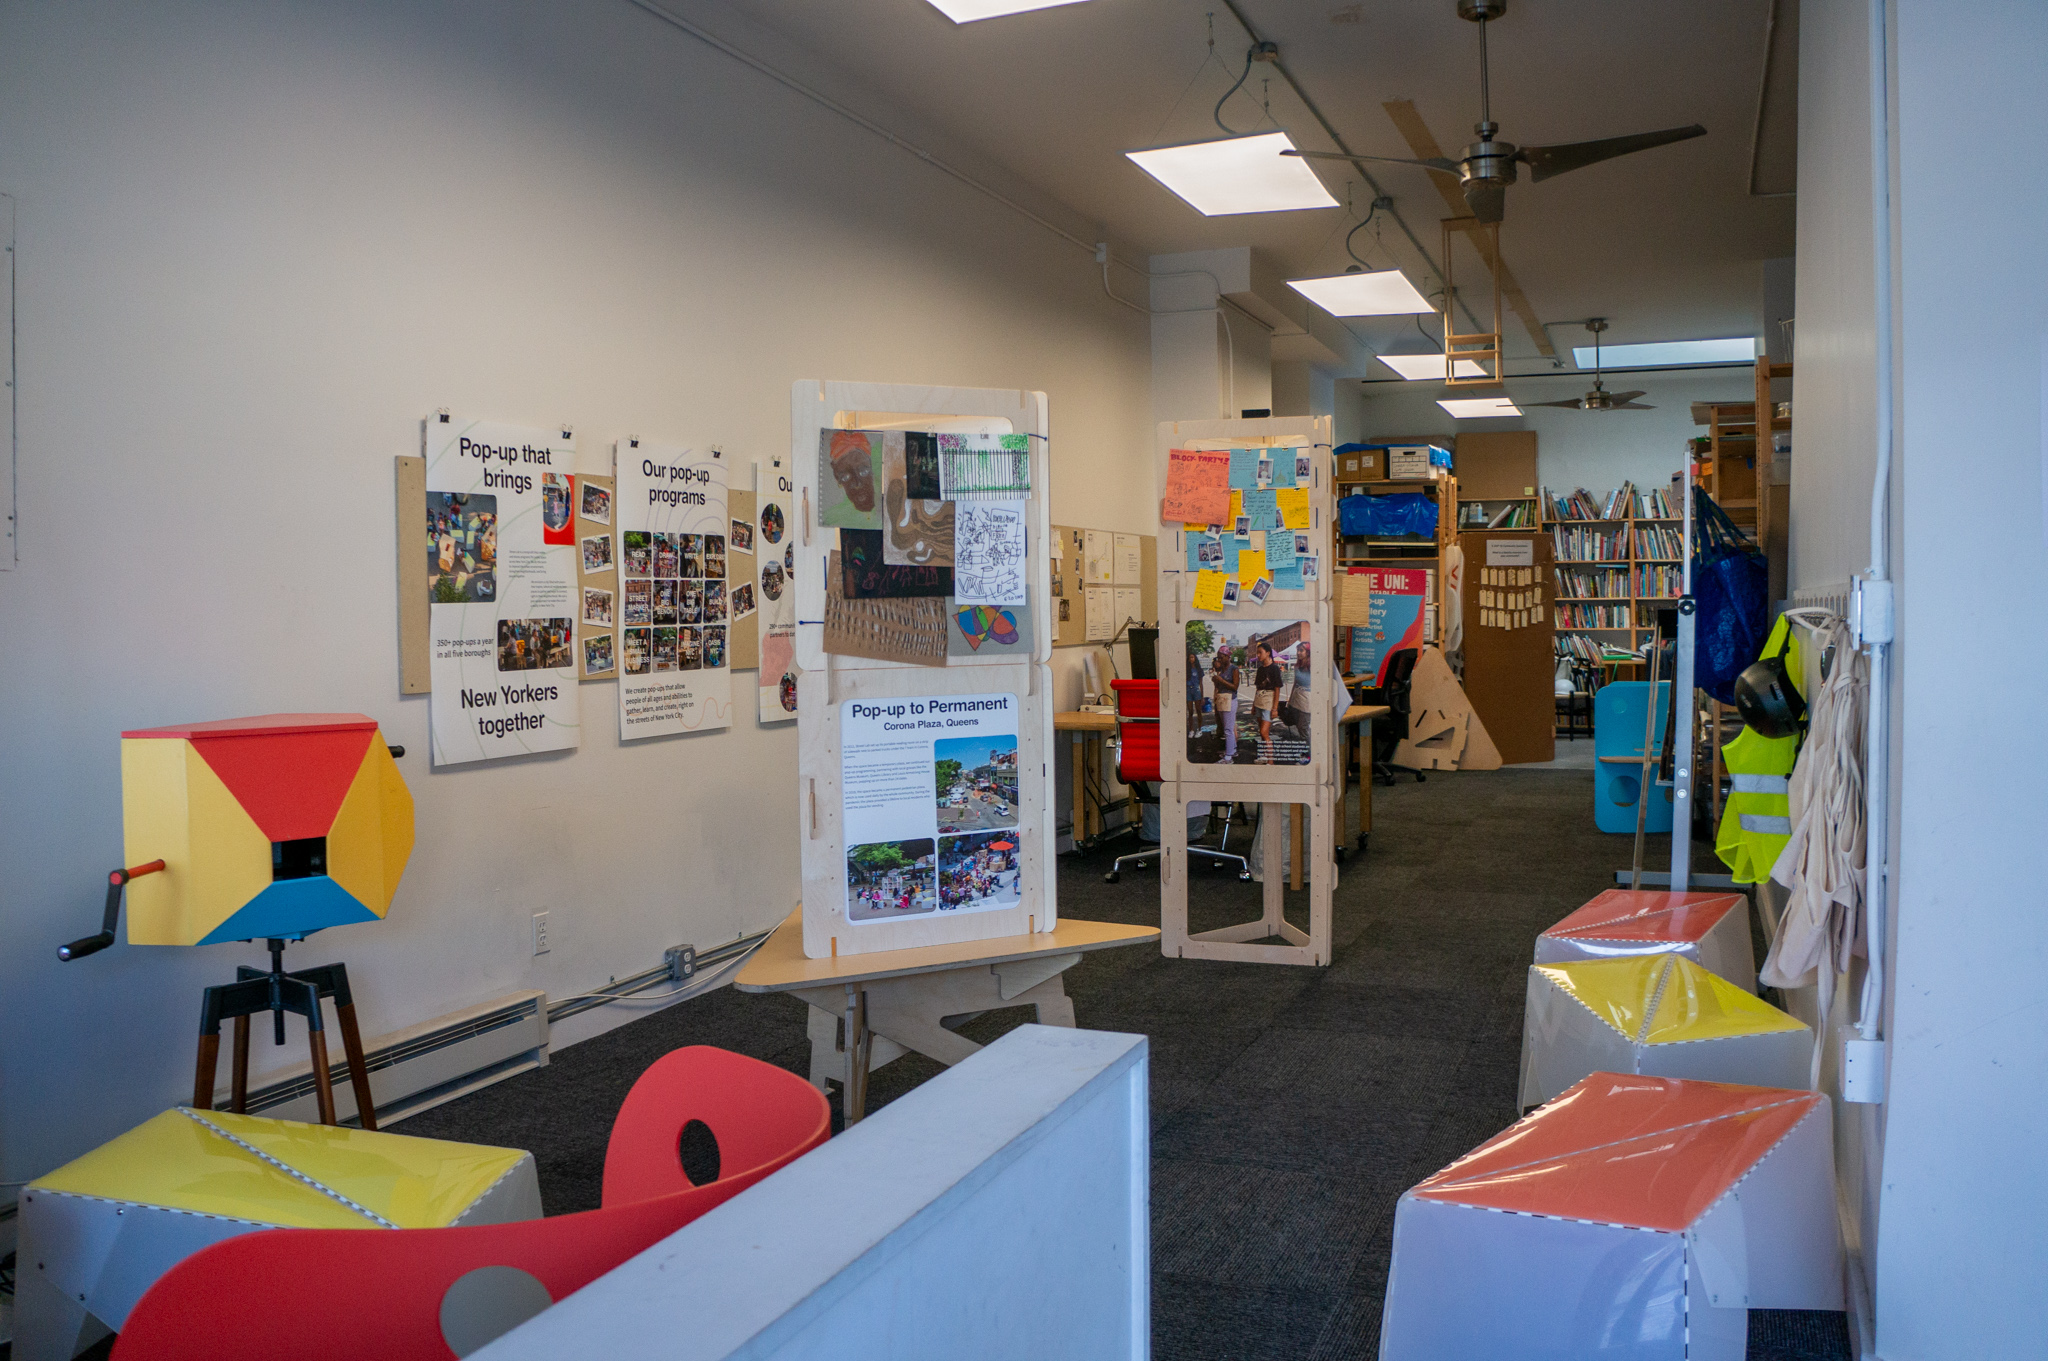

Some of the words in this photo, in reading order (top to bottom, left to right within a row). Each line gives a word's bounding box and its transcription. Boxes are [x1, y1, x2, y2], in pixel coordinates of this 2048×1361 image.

[459, 437, 518, 466] Pop-up
[522, 444, 552, 465] that
[484, 467, 533, 494] brings
[642, 459, 666, 478] Our
[670, 465, 710, 486] pop-up
[778, 476, 793, 493] Ou
[649, 488, 706, 508] programs
[1384, 574, 1409, 590] UNI:
[436, 639, 451, 647] 350+
[452, 639, 477, 648] pop-ups
[481, 637, 495, 646] year
[436, 651, 443, 659] in
[444, 650, 452, 658] all
[452, 649, 464, 658] five
[464, 648, 491, 658] boroughs
[460, 688, 497, 709] New
[500, 683, 559, 705] Yorkers
[647, 685, 665, 694] pop-ups
[626, 697, 641, 705] people
[672, 692, 687, 700] abilities
[678, 702, 688, 710] right
[675, 712, 684, 720] City.
[852, 704, 906, 720] Pop-up
[909, 702, 925, 715] to
[929, 697, 1008, 714] Permanent
[478, 711, 545, 739] together
[883, 721, 915, 731] Corona
[917, 720, 944, 729] Plaza,
[946, 718, 979, 728] Queens
